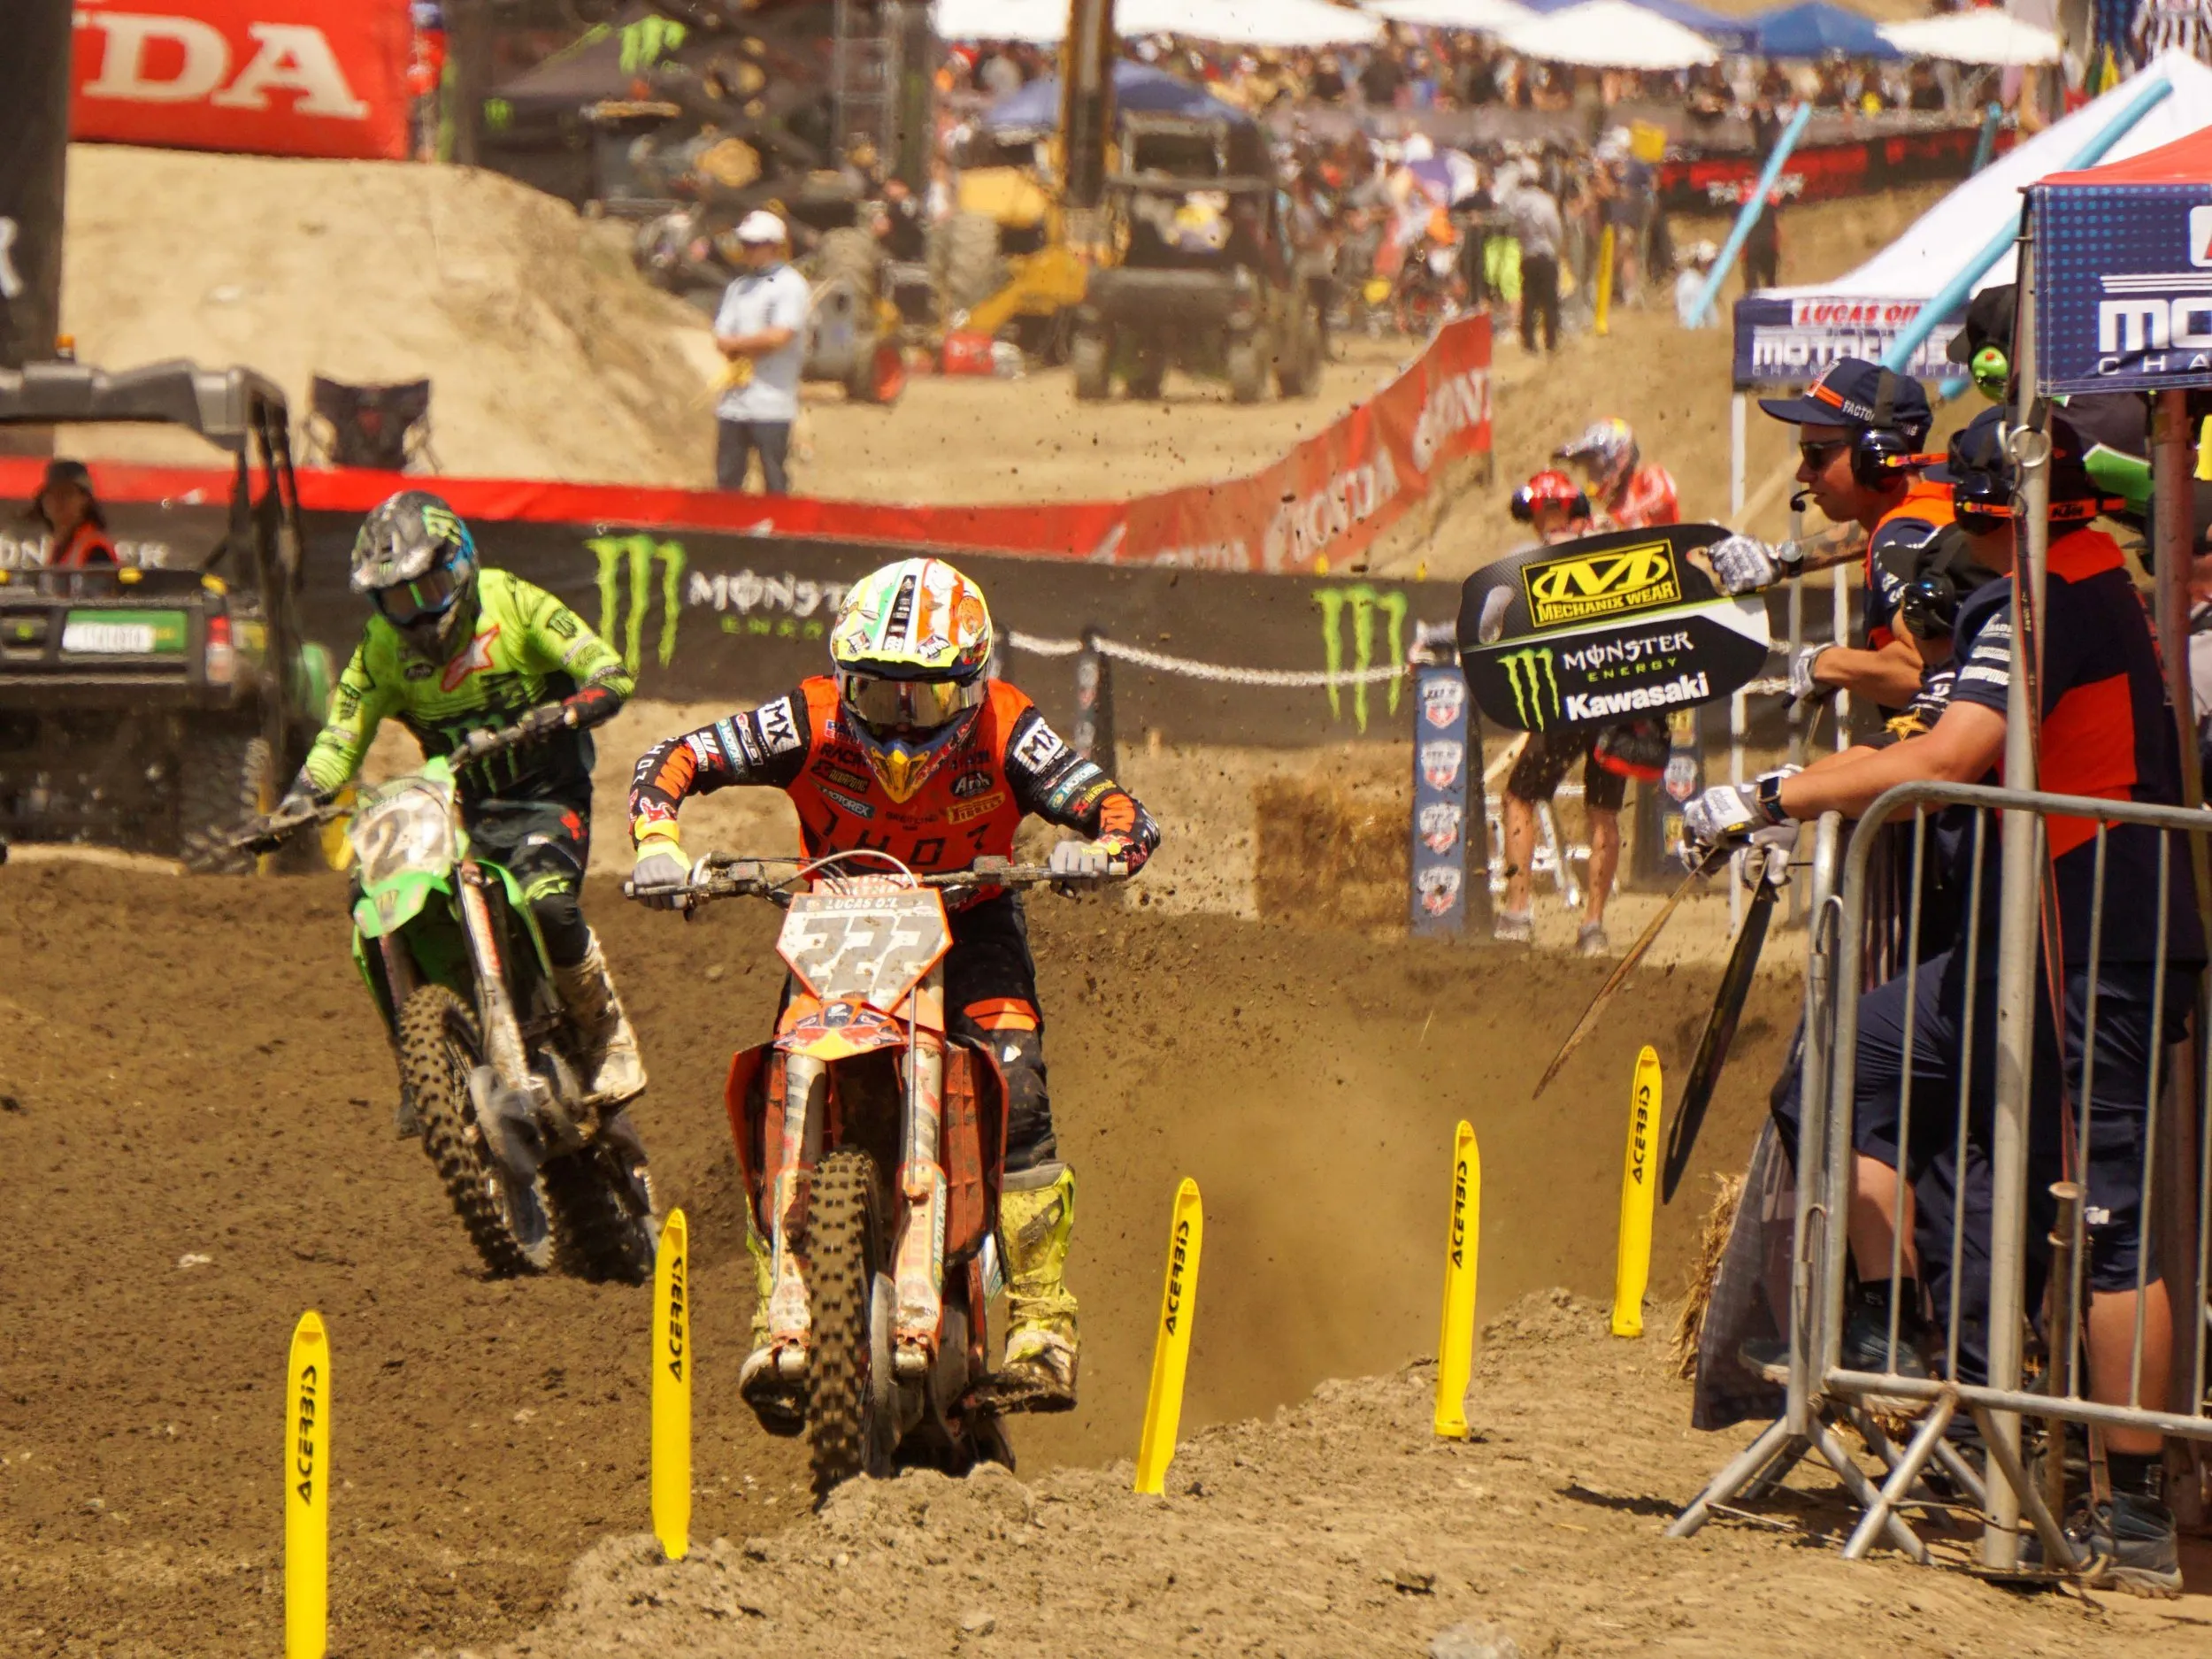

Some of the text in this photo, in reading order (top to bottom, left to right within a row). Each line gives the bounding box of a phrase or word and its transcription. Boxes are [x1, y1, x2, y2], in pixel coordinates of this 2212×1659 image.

[1799, 304, 1880, 326] LUCAS
[688, 566, 848, 617] MONST
[1538, 581, 1675, 622] MECHANIX WEAR
[1563, 630, 1695, 672] MONSTER
[1587, 657, 1678, 682] ENERGY
[1565, 671, 1709, 721] Kawasaki
[794, 916, 943, 993] 222
